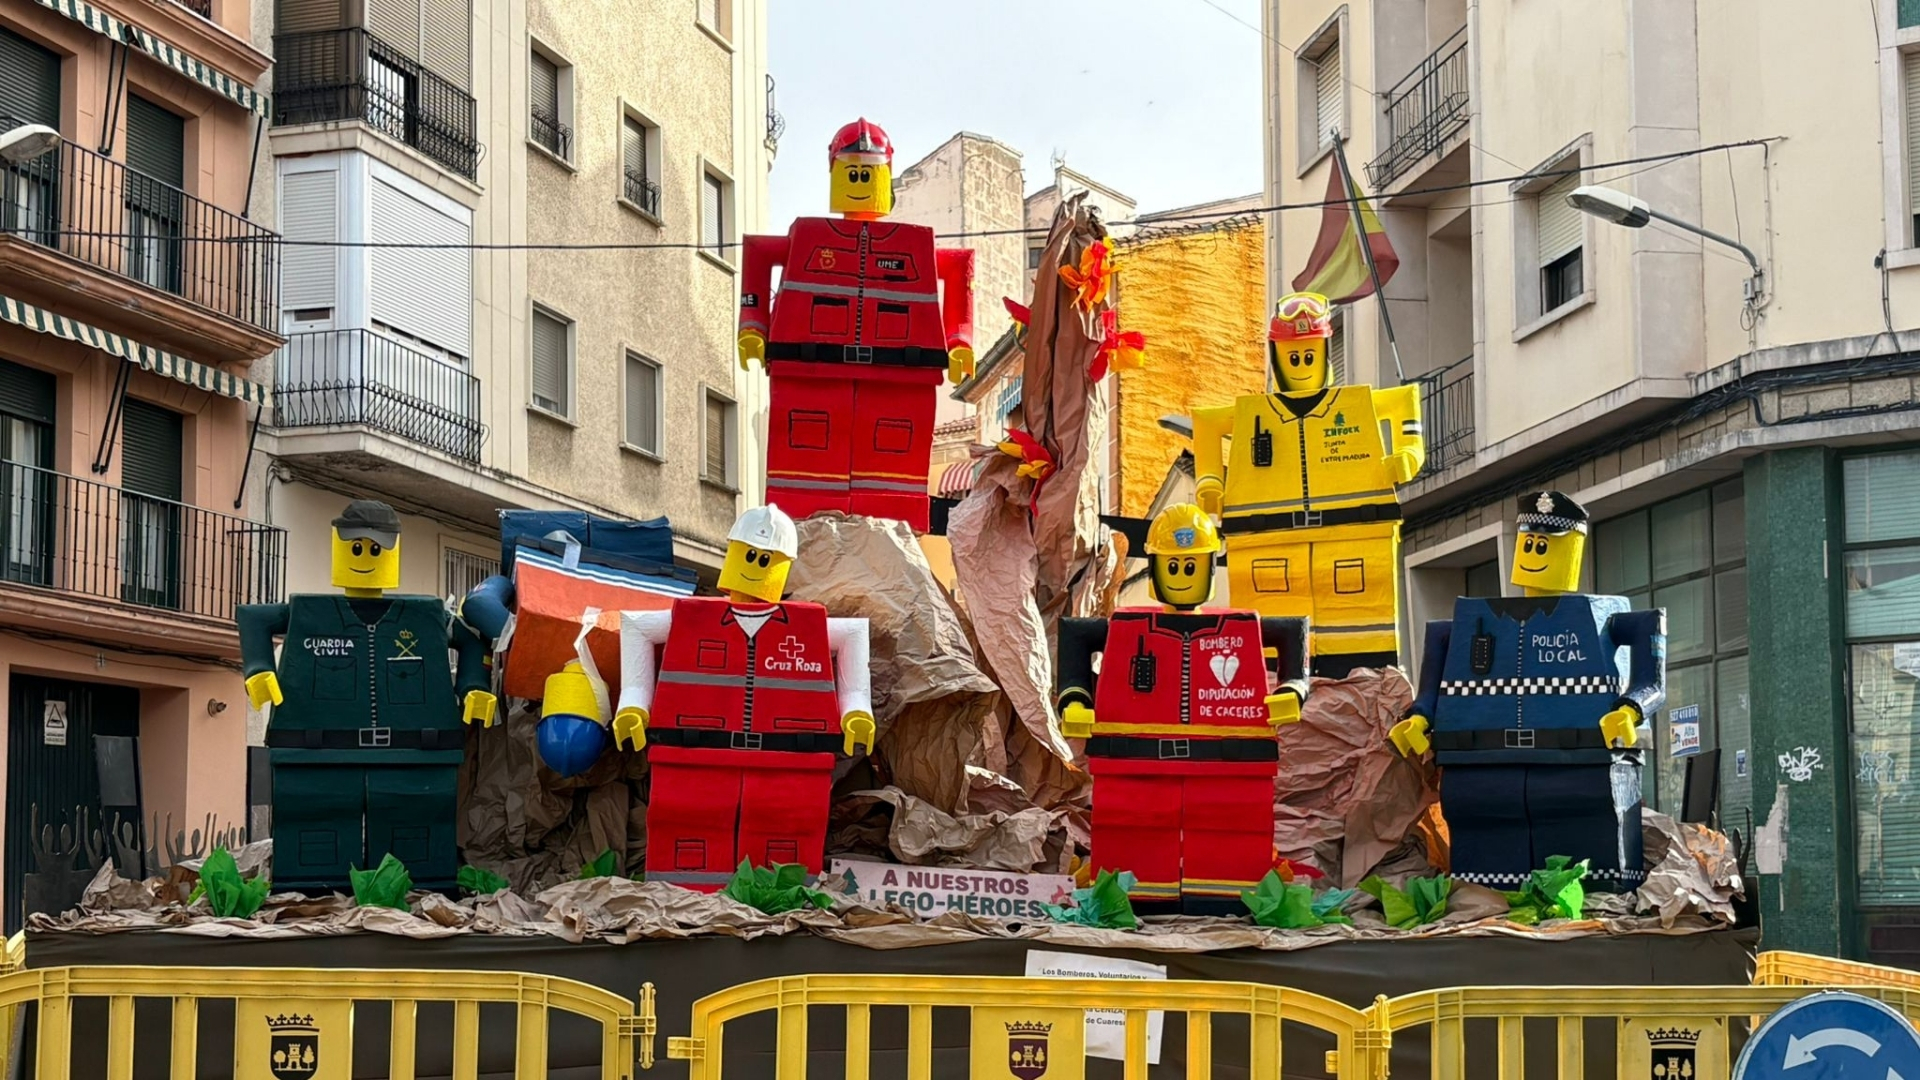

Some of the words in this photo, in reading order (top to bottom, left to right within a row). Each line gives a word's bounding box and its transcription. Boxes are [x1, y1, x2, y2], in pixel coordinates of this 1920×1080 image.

[877, 260, 899, 269] UME
[1324, 440, 1346, 448] JUNTA
[303, 638, 354, 649] GUARDIA
[1200, 636, 1243, 650] BOMBERO
[1532, 629, 1579, 647] POLICÍA
[313, 648, 349, 656] CIVIL
[1538, 649, 1587, 662] LOCAL
[764, 656, 792, 671] Cruz
[1198, 684, 1255, 700] DIPUTACIÓN
[1200, 705, 1213, 716] DE
[1216, 706, 1263, 719] CACERES
[882, 869, 898, 886] A
[907, 870, 1029, 895] NUESTROS
[1042, 968, 1055, 976] Los
